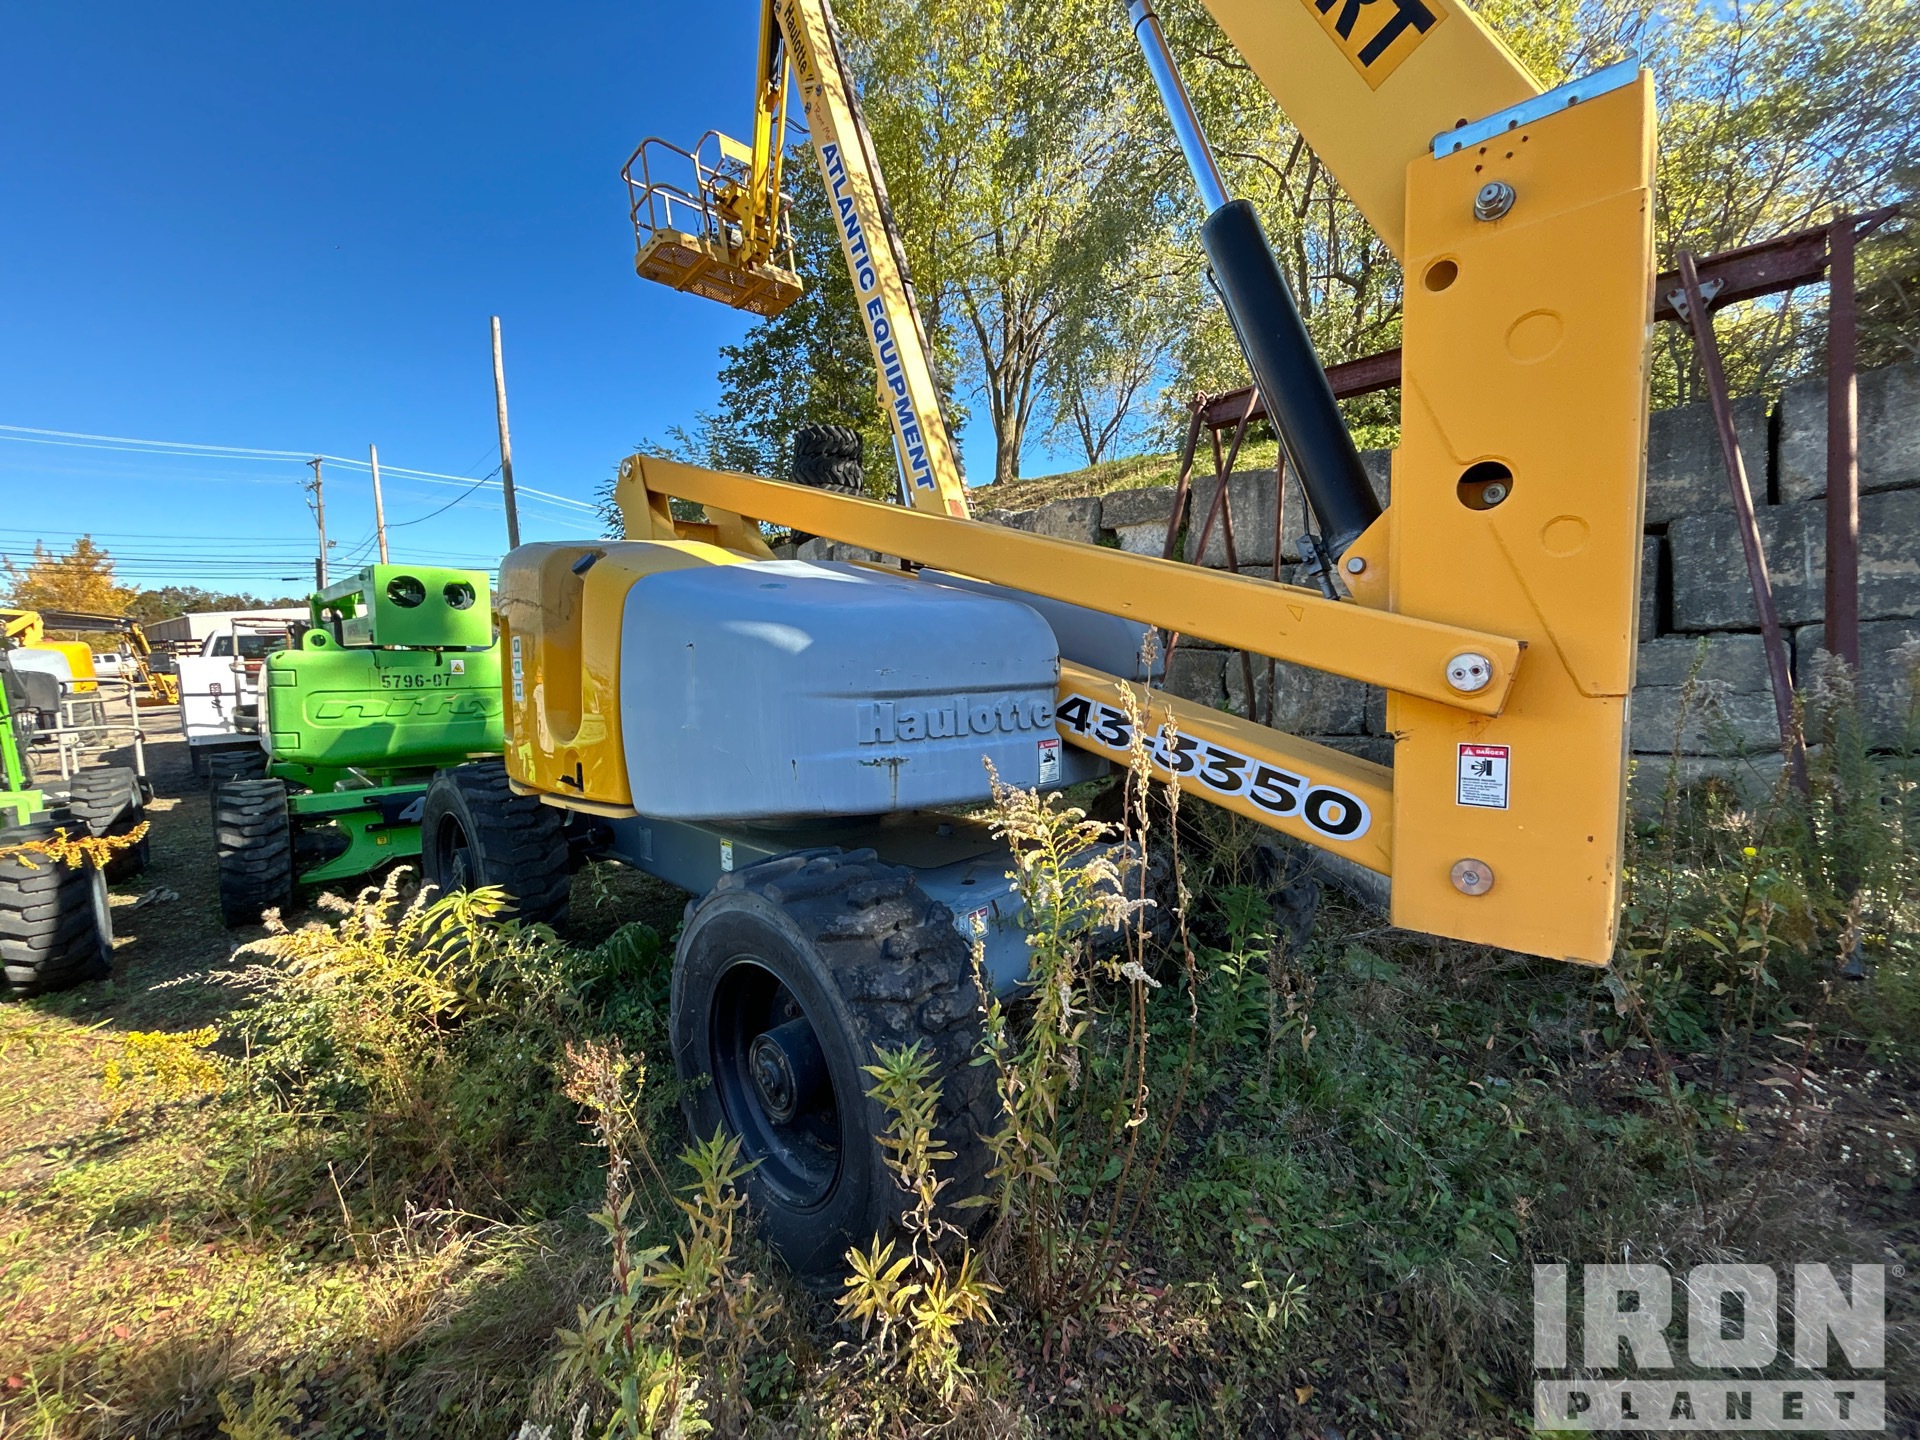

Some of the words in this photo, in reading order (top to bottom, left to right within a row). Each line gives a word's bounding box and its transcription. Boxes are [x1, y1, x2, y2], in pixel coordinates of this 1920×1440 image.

[784, 2, 808, 75] Haulotte
[822, 143, 875, 291] ATLANTIC
[866, 296, 934, 489] EQUIPMENT
[381, 673, 450, 689] 5796-07
[857, 696, 1053, 746] Haulotte
[1056, 696, 1363, 836] 43-3350
